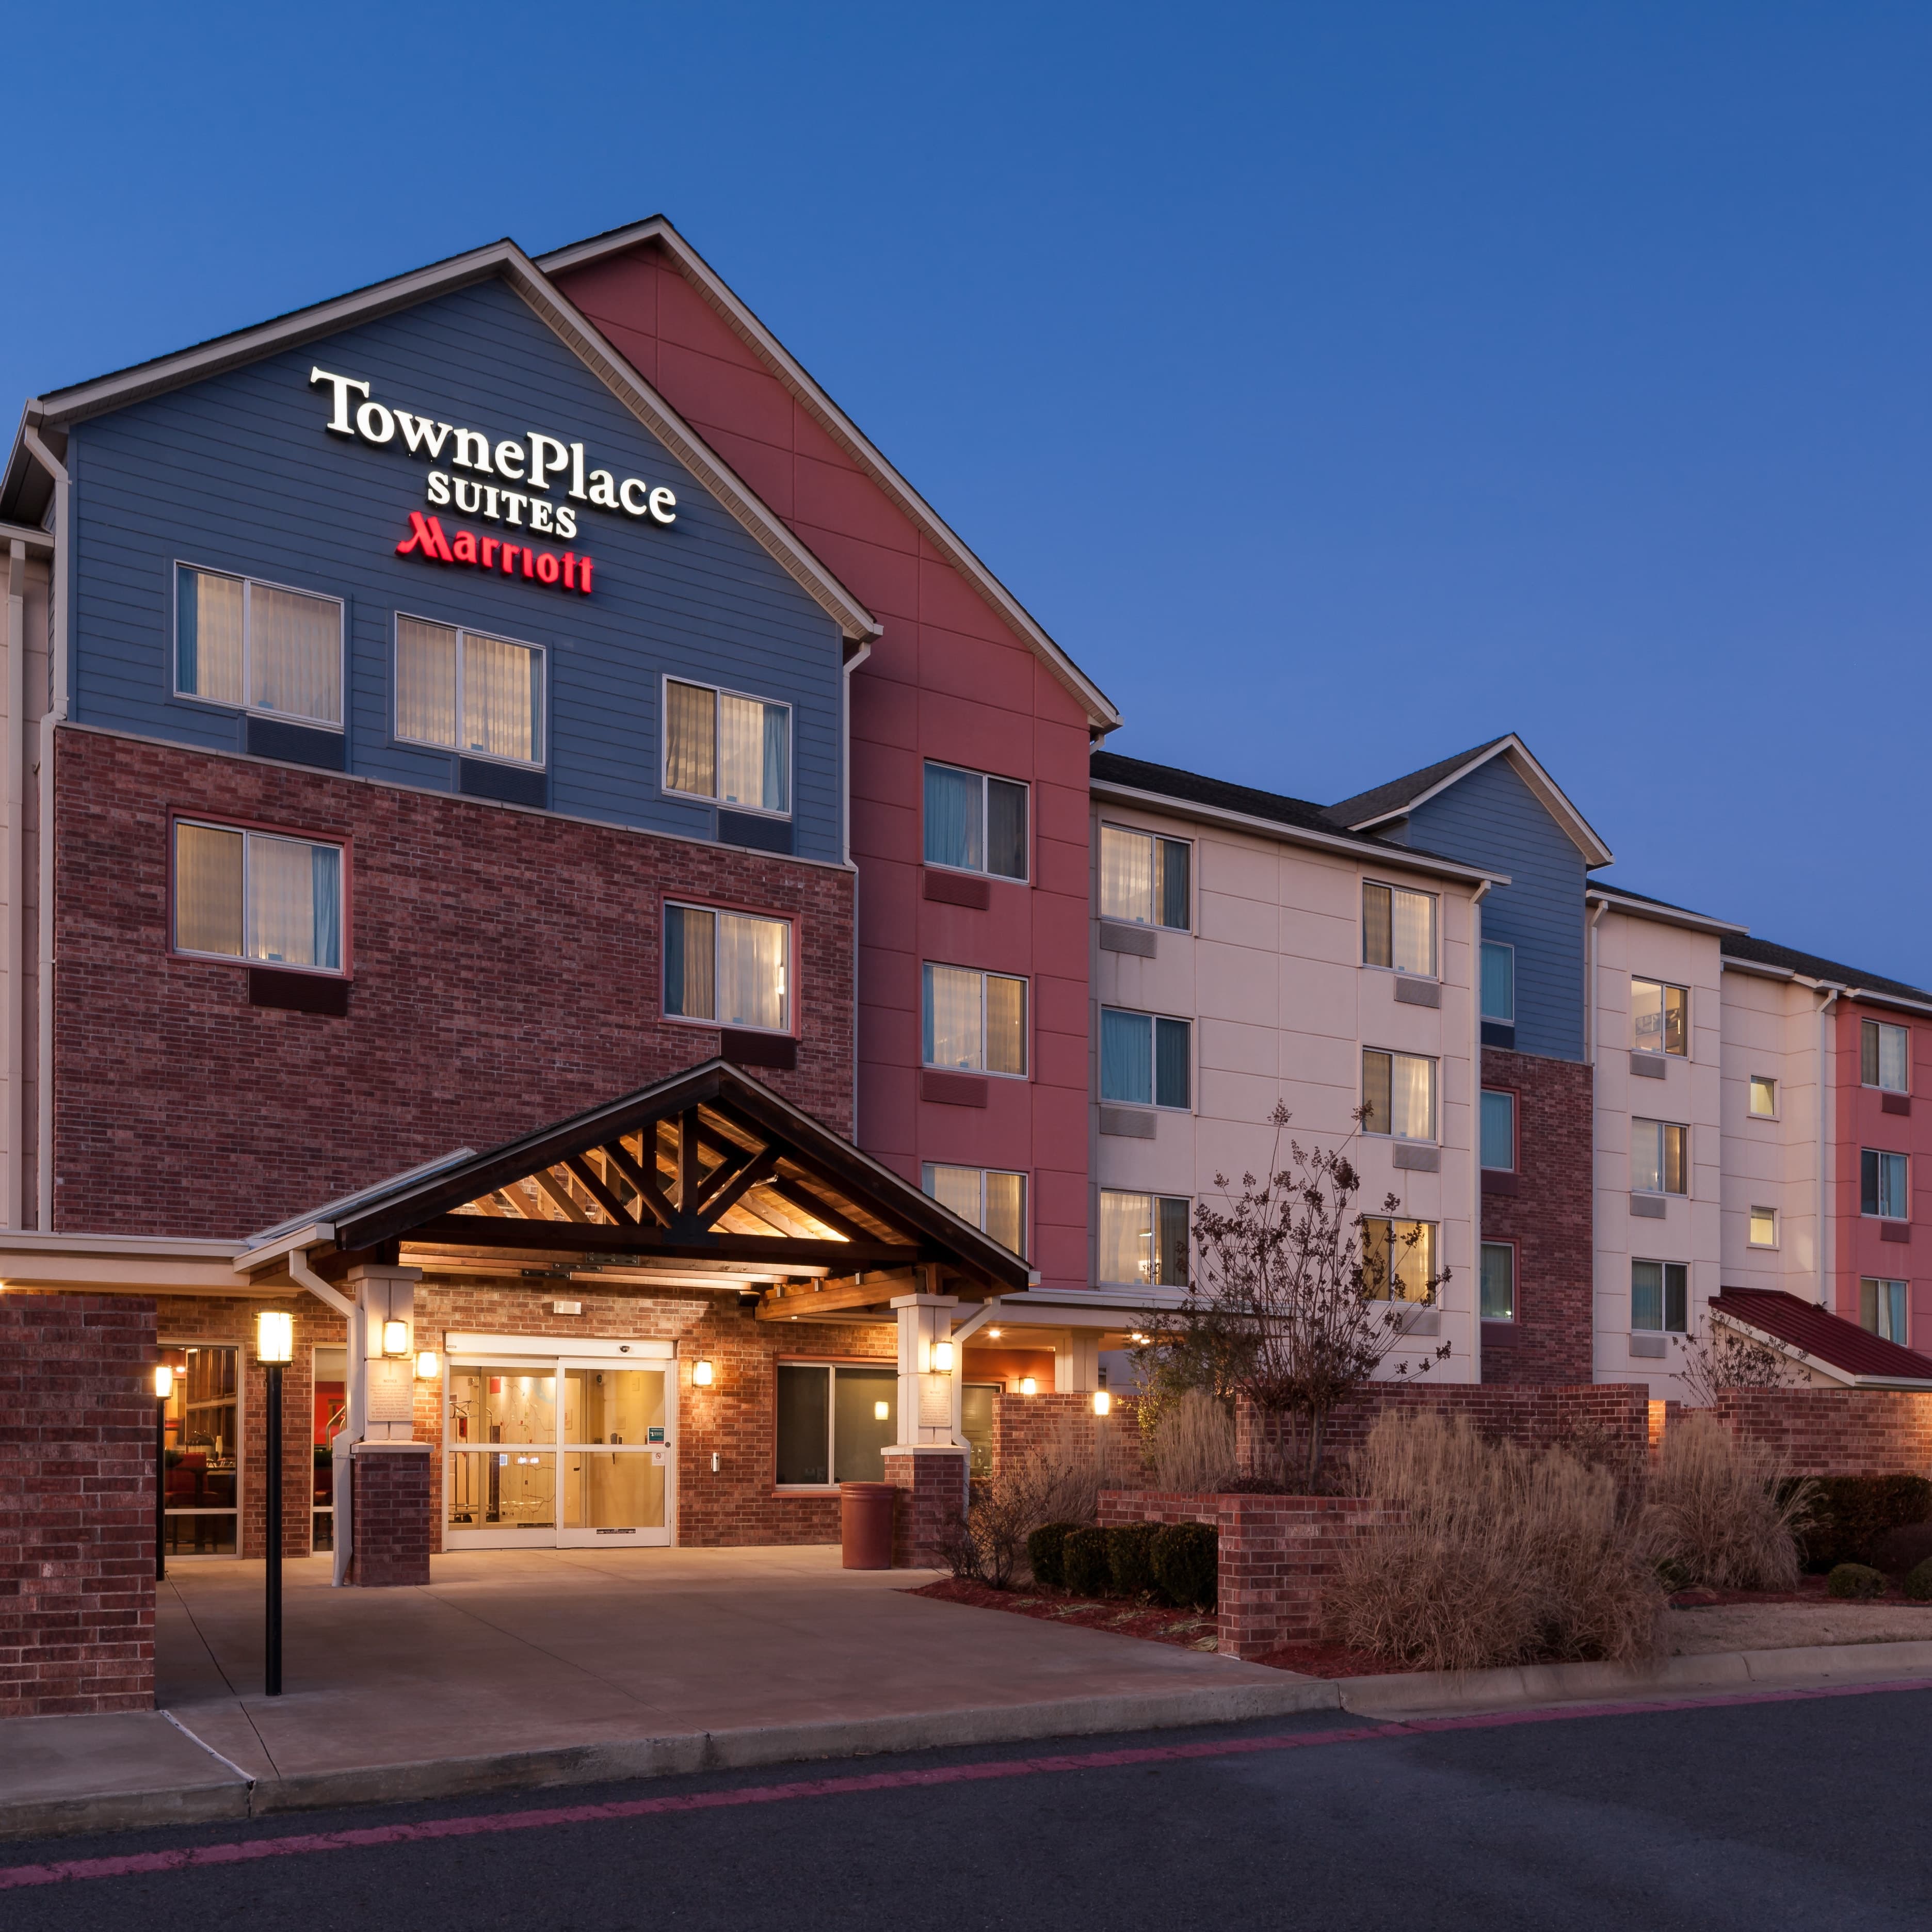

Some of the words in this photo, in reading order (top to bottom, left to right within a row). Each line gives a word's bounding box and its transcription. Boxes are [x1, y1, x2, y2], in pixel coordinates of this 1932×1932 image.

[310, 366, 677, 524] TownePlace
[427, 471, 578, 539] SUITES
[395, 511, 594, 595] Marriott
